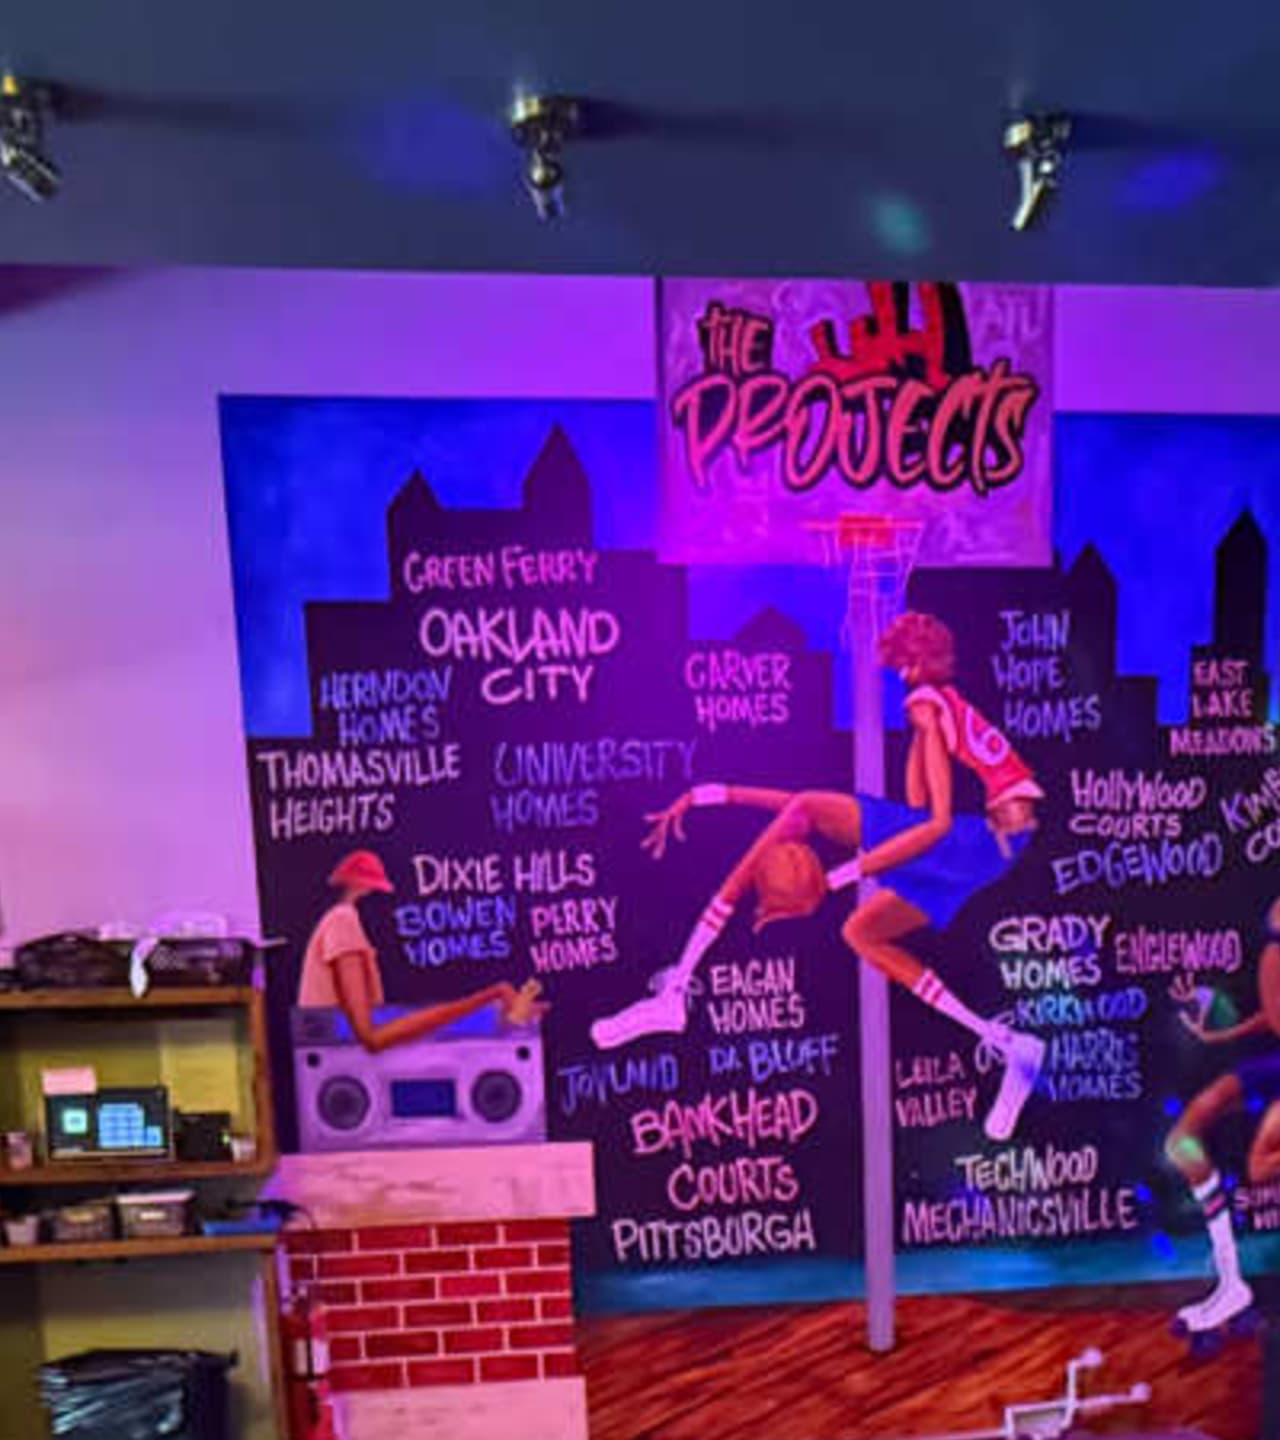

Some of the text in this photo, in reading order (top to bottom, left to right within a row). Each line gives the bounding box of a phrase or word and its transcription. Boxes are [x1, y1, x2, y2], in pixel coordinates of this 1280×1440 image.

[673, 360, 1038, 495] PROJECTS
[403, 546, 599, 593] GREEN FERRY
[419, 606, 620, 662] OAKLAND
[998, 611, 1070, 652] JOHN
[321, 667, 452, 710] HERNDON
[480, 664, 594, 704] CITY
[992, 654, 1064, 692] HOPE
[1193, 658, 1249, 688] EAST
[694, 692, 790, 734] HOMES
[1004, 694, 1102, 743] HOMES
[1193, 689, 1253, 719] LAKE
[338, 705, 440, 746] HOMES
[257, 743, 461, 791] THOMASVILLE
[493, 739, 698, 787] UNIVERSITY
[270, 793, 396, 841] HEIGHTS
[489, 791, 599, 832] HOMES
[1069, 811, 1183, 840] COURTS
[413, 850, 596, 895] DIXIE HILLS
[1051, 832, 1223, 895] EDGEWOOD
[396, 896, 517, 937] BOWEN
[531, 897, 618, 937] PERRY
[988, 914, 1111, 952] GRADY
[403, 930, 511, 967] HOMES
[530, 934, 618, 974] HOMES
[711, 957, 795, 996] EAGAN
[1000, 952, 1102, 990] HOMES
[709, 994, 805, 1034] HOMES
[748, 1034, 839, 1084] BLUFF
[1048, 1070, 1144, 1101] HOMES
[630, 1088, 819, 1158] BANKHEAD
[895, 1086, 977, 1127] VALLEY
[668, 1156, 799, 1211] COURTS
[954, 1145, 1099, 1193] TECHWOOD
[902, 1189, 1139, 1245] MECHANICSVILLE
